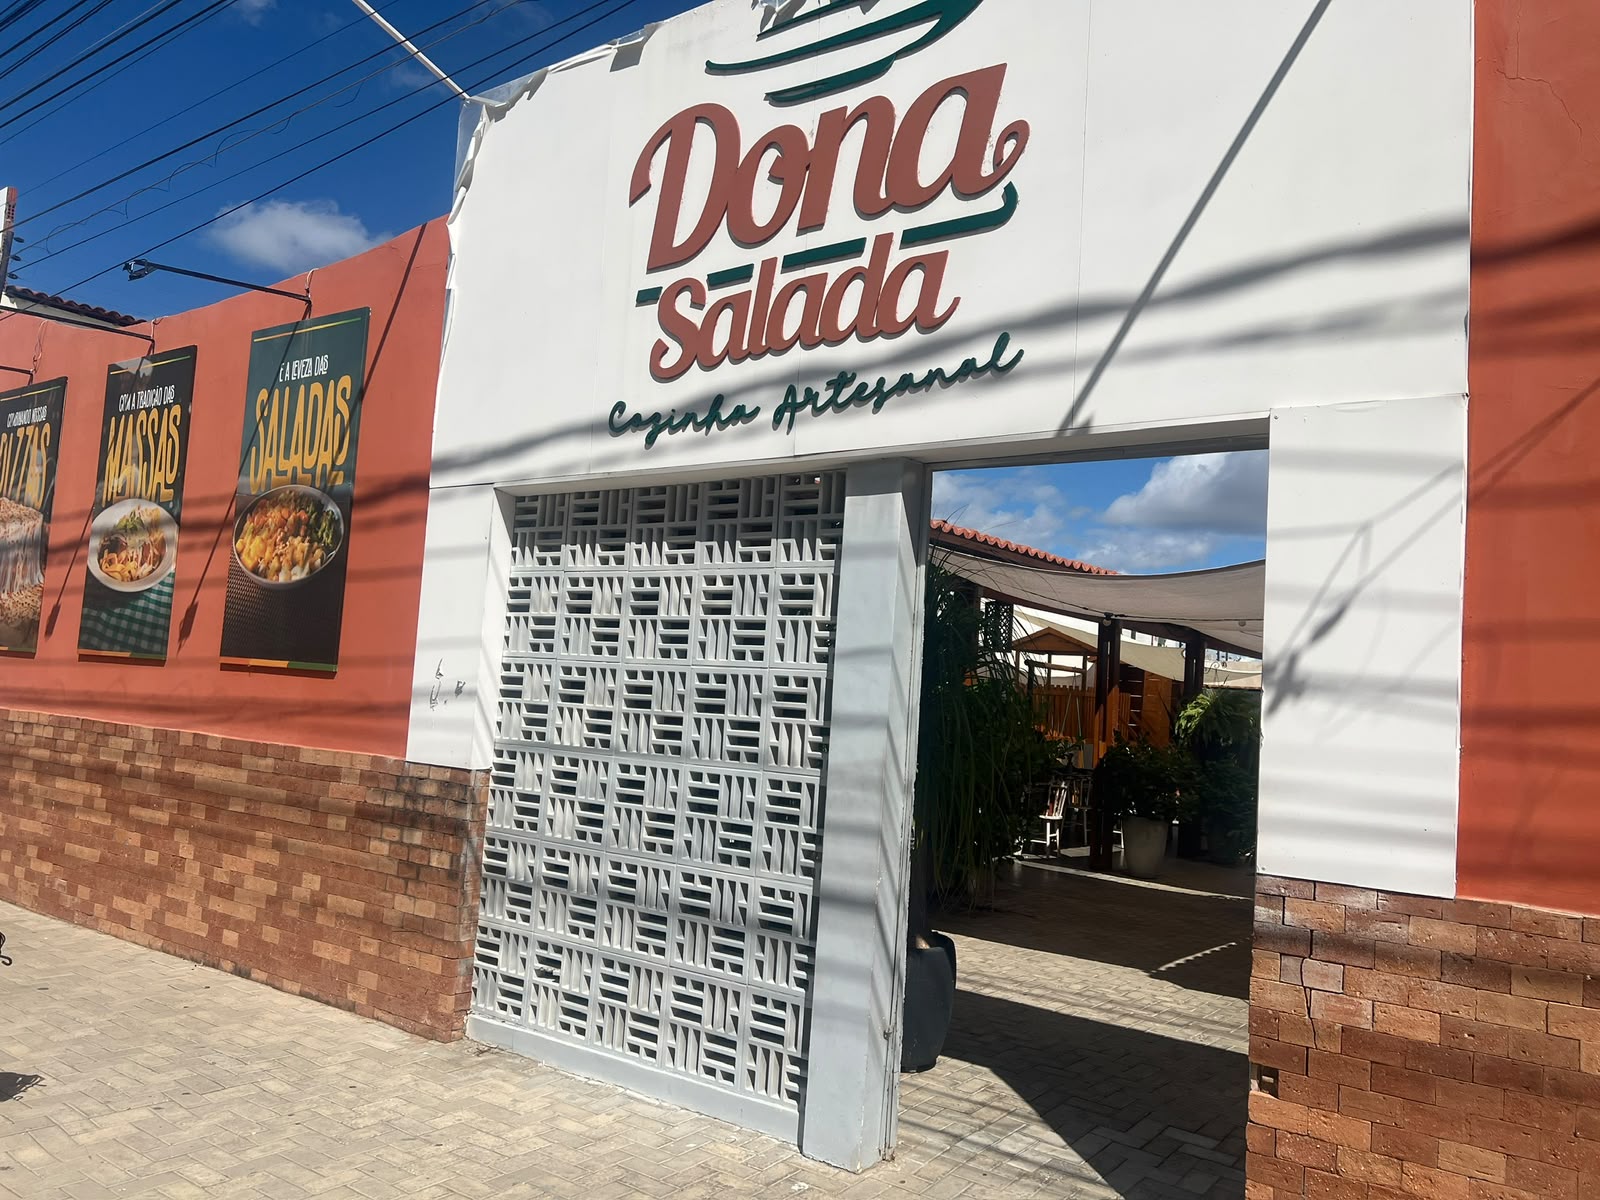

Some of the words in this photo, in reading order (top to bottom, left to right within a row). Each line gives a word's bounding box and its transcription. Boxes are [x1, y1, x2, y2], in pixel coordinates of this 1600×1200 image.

[629, 63, 1030, 273] Dona
[649, 232, 961, 381] Salada
[130, 392, 136, 410] A
[163, 384, 175, 405] DAS
[284, 361, 290, 381] A
[291, 357, 313, 380] LEVEZA
[314, 354, 329, 376] DAS
[608, 393, 761, 446] Cozinha
[772, 332, 1024, 431] Artesanal
[101, 404, 182, 508] MASSAS
[249, 375, 352, 495] SALADAS
